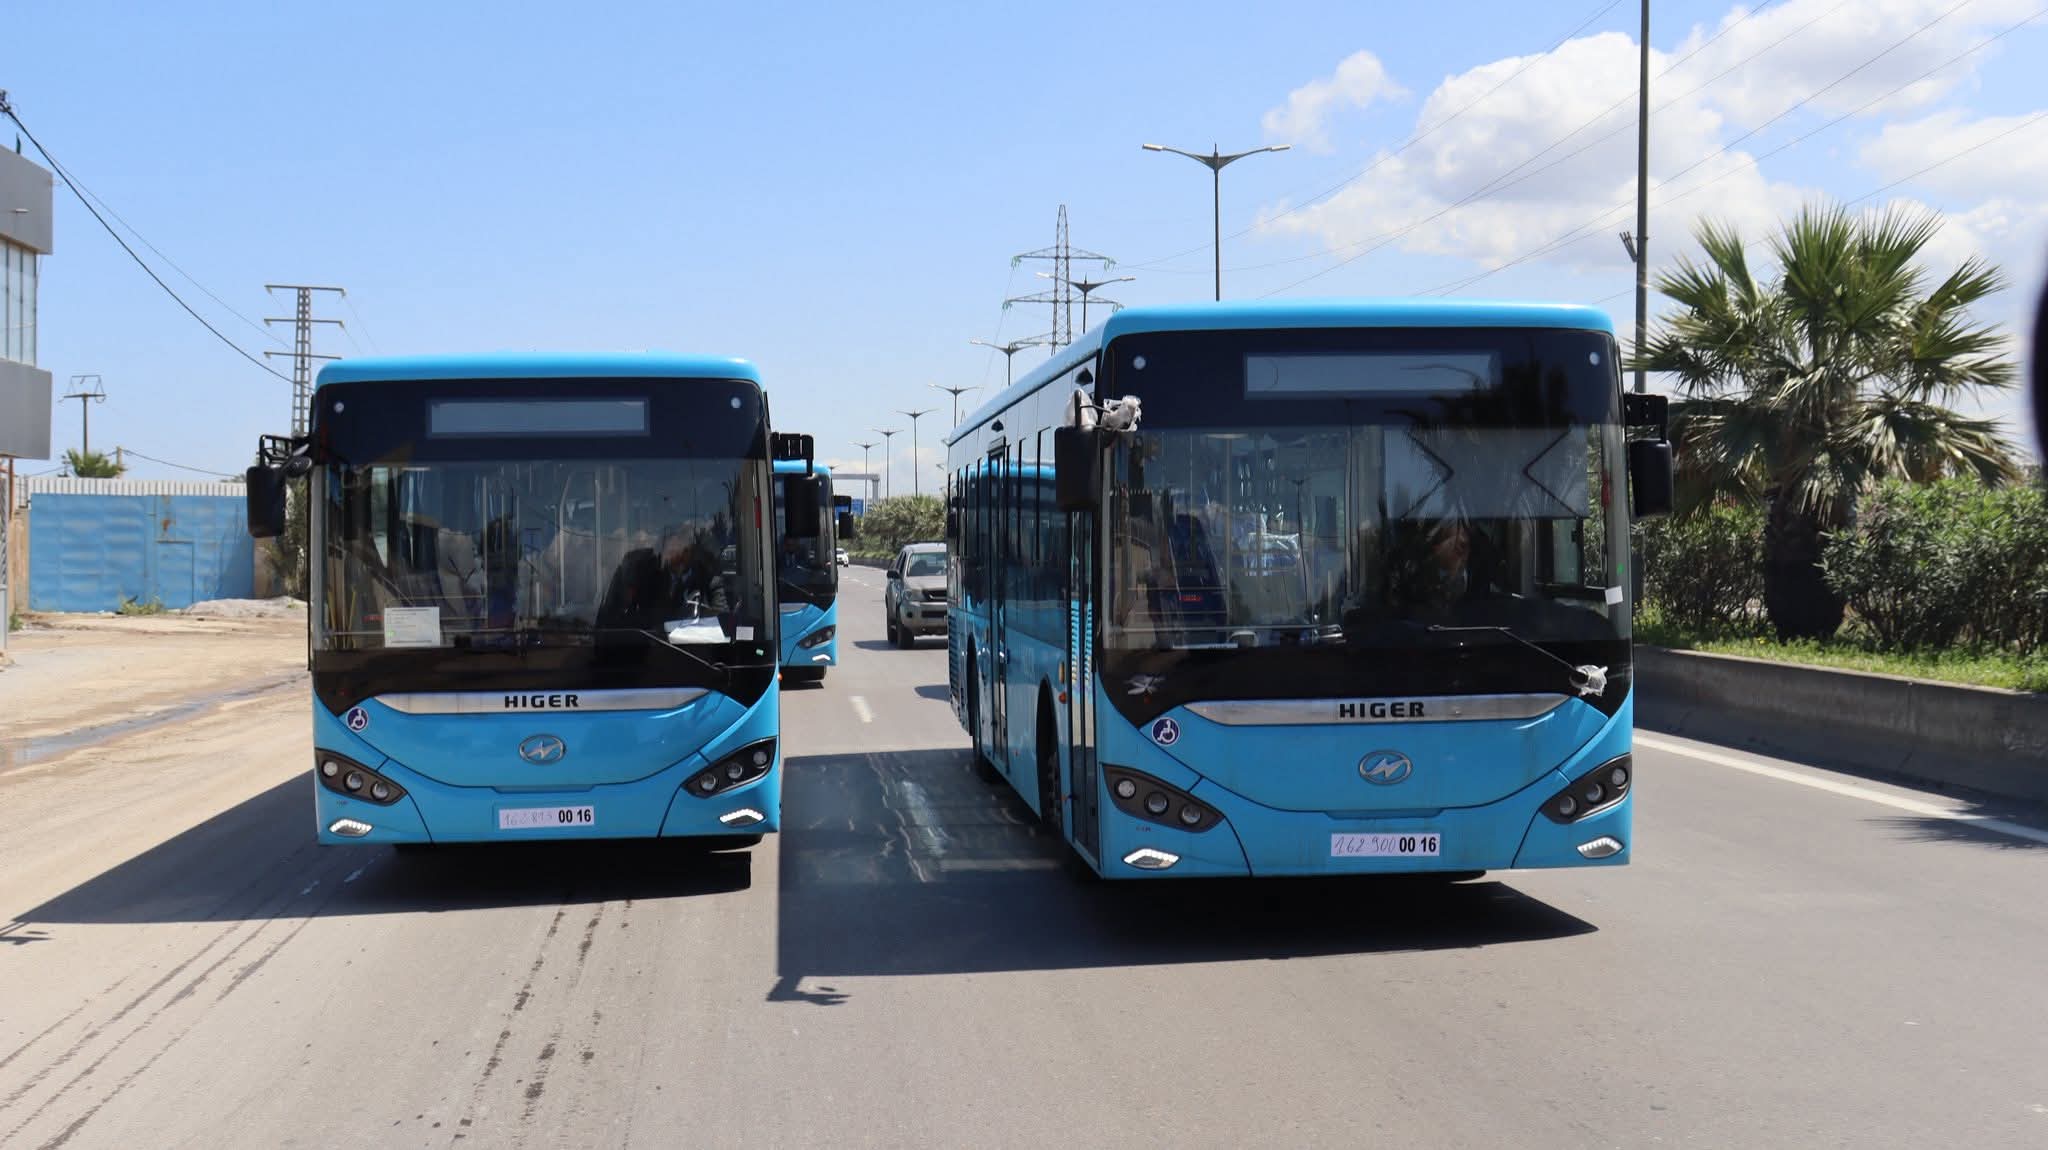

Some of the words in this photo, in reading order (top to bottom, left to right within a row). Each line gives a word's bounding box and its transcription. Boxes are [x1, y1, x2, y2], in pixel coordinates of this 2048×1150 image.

[504, 694, 579, 709] HIGER
[1339, 701, 1425, 718] HIGER
[558, 809, 574, 824] 00
[577, 808, 592, 823] 16
[1334, 836, 1366, 854] 162
[1399, 836, 1416, 853] 00
[1420, 836, 1437, 853] 16
